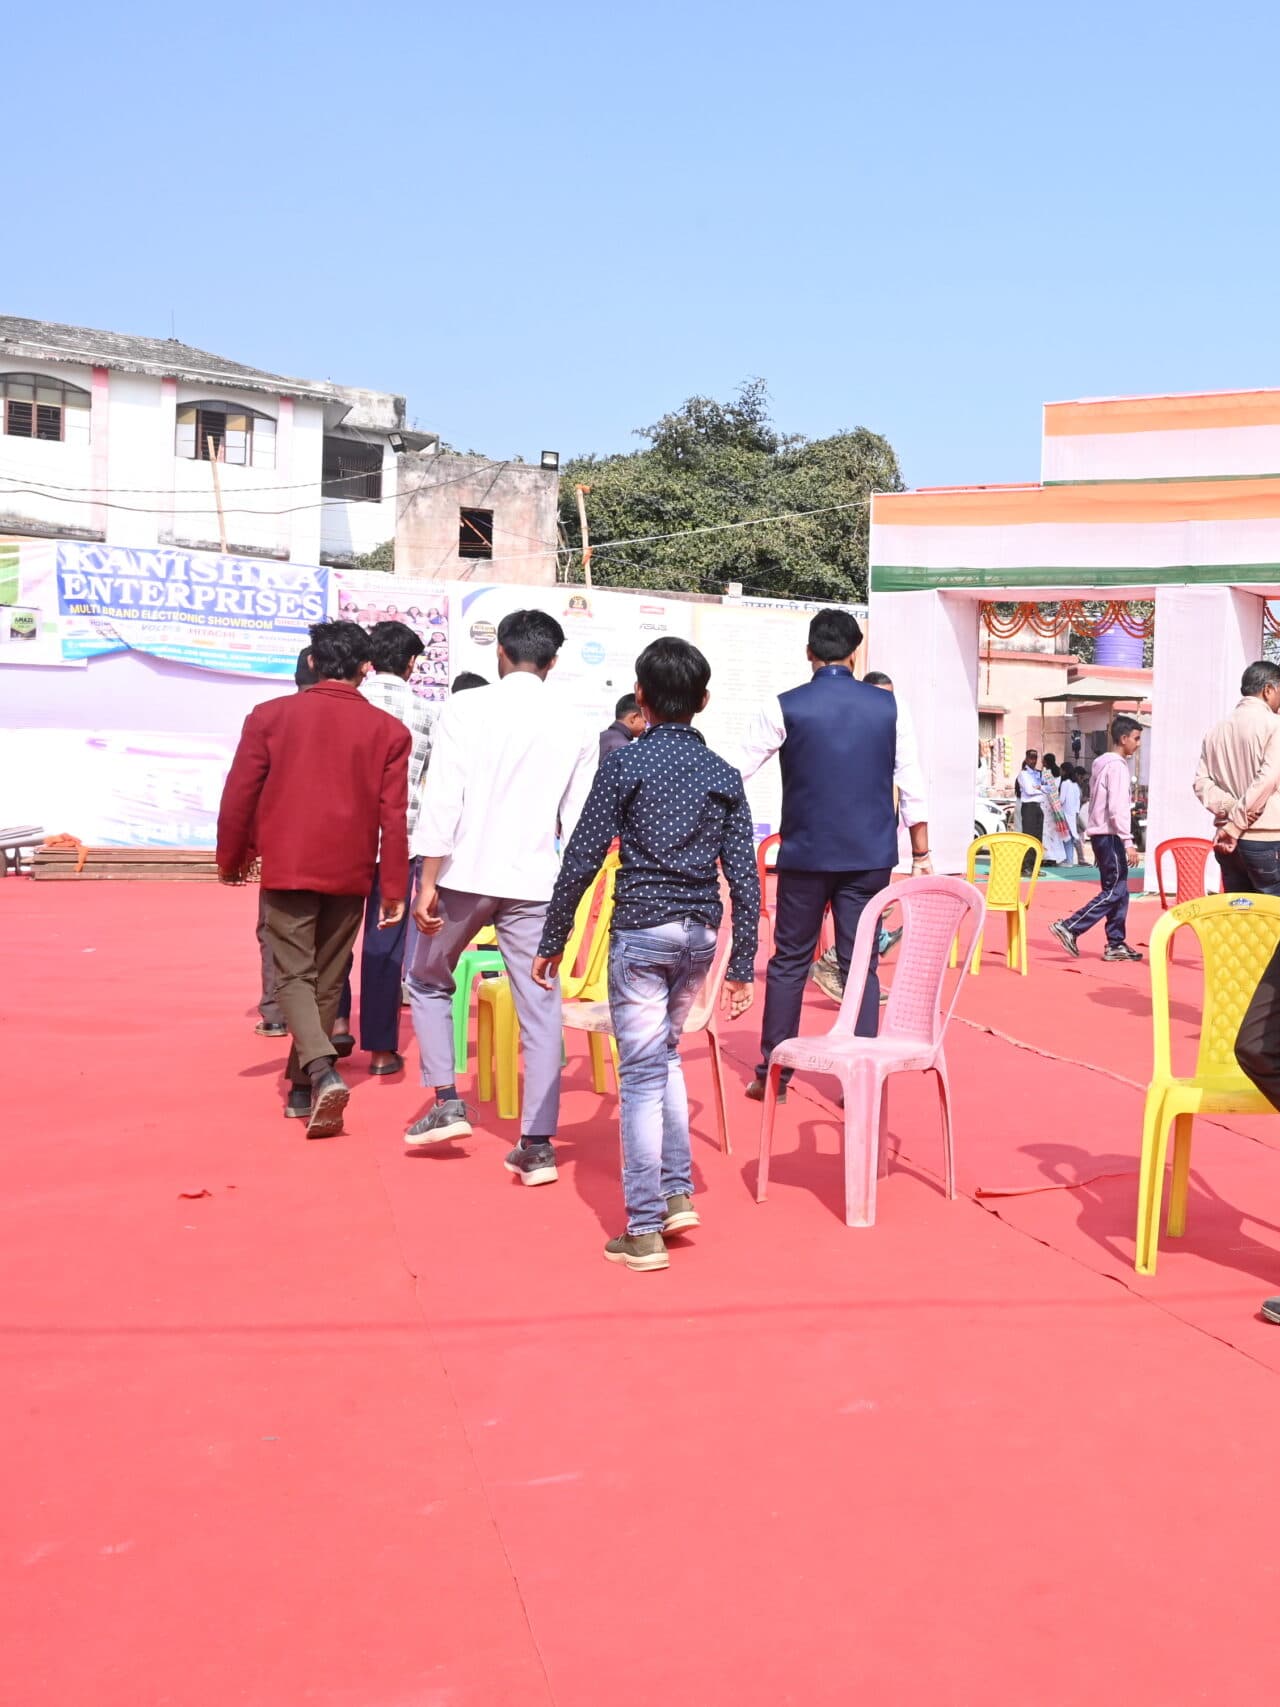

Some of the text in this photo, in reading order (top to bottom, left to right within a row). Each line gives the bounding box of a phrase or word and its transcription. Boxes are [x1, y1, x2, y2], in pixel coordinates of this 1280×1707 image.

[61, 543, 324, 592] KANISHKA
[62, 573, 323, 619] ENTERPRISES
[70, 604, 273, 630] MULTI BRAND ELECTRONIC SHOWROOM
